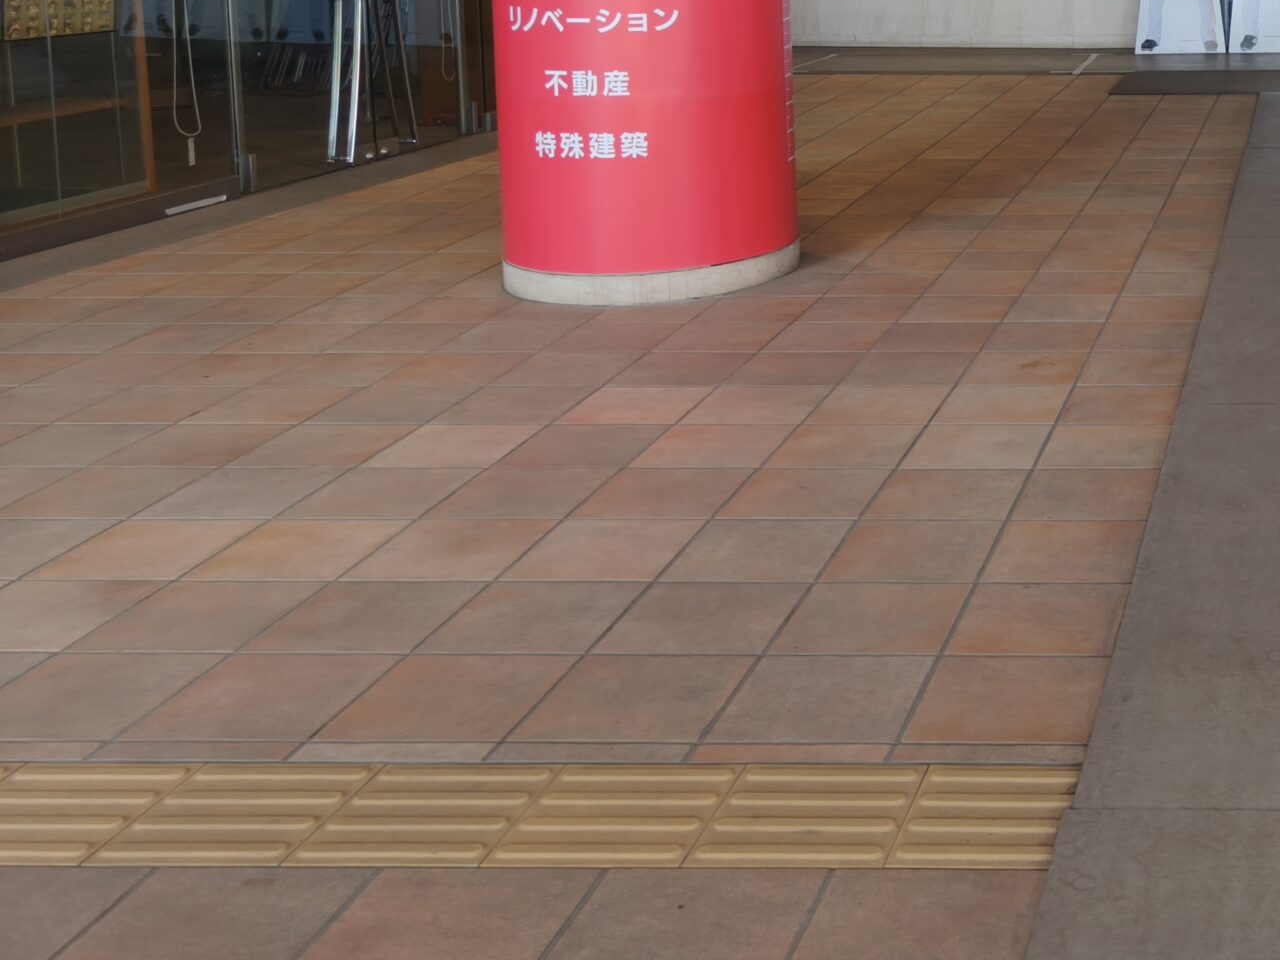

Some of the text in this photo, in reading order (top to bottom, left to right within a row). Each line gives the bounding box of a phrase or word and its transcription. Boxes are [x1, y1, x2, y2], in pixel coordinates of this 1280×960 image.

[508, 6, 680, 33] リノベーション
[544, 69, 631, 97] 不動産
[535, 131, 649, 159] 特殊建築
